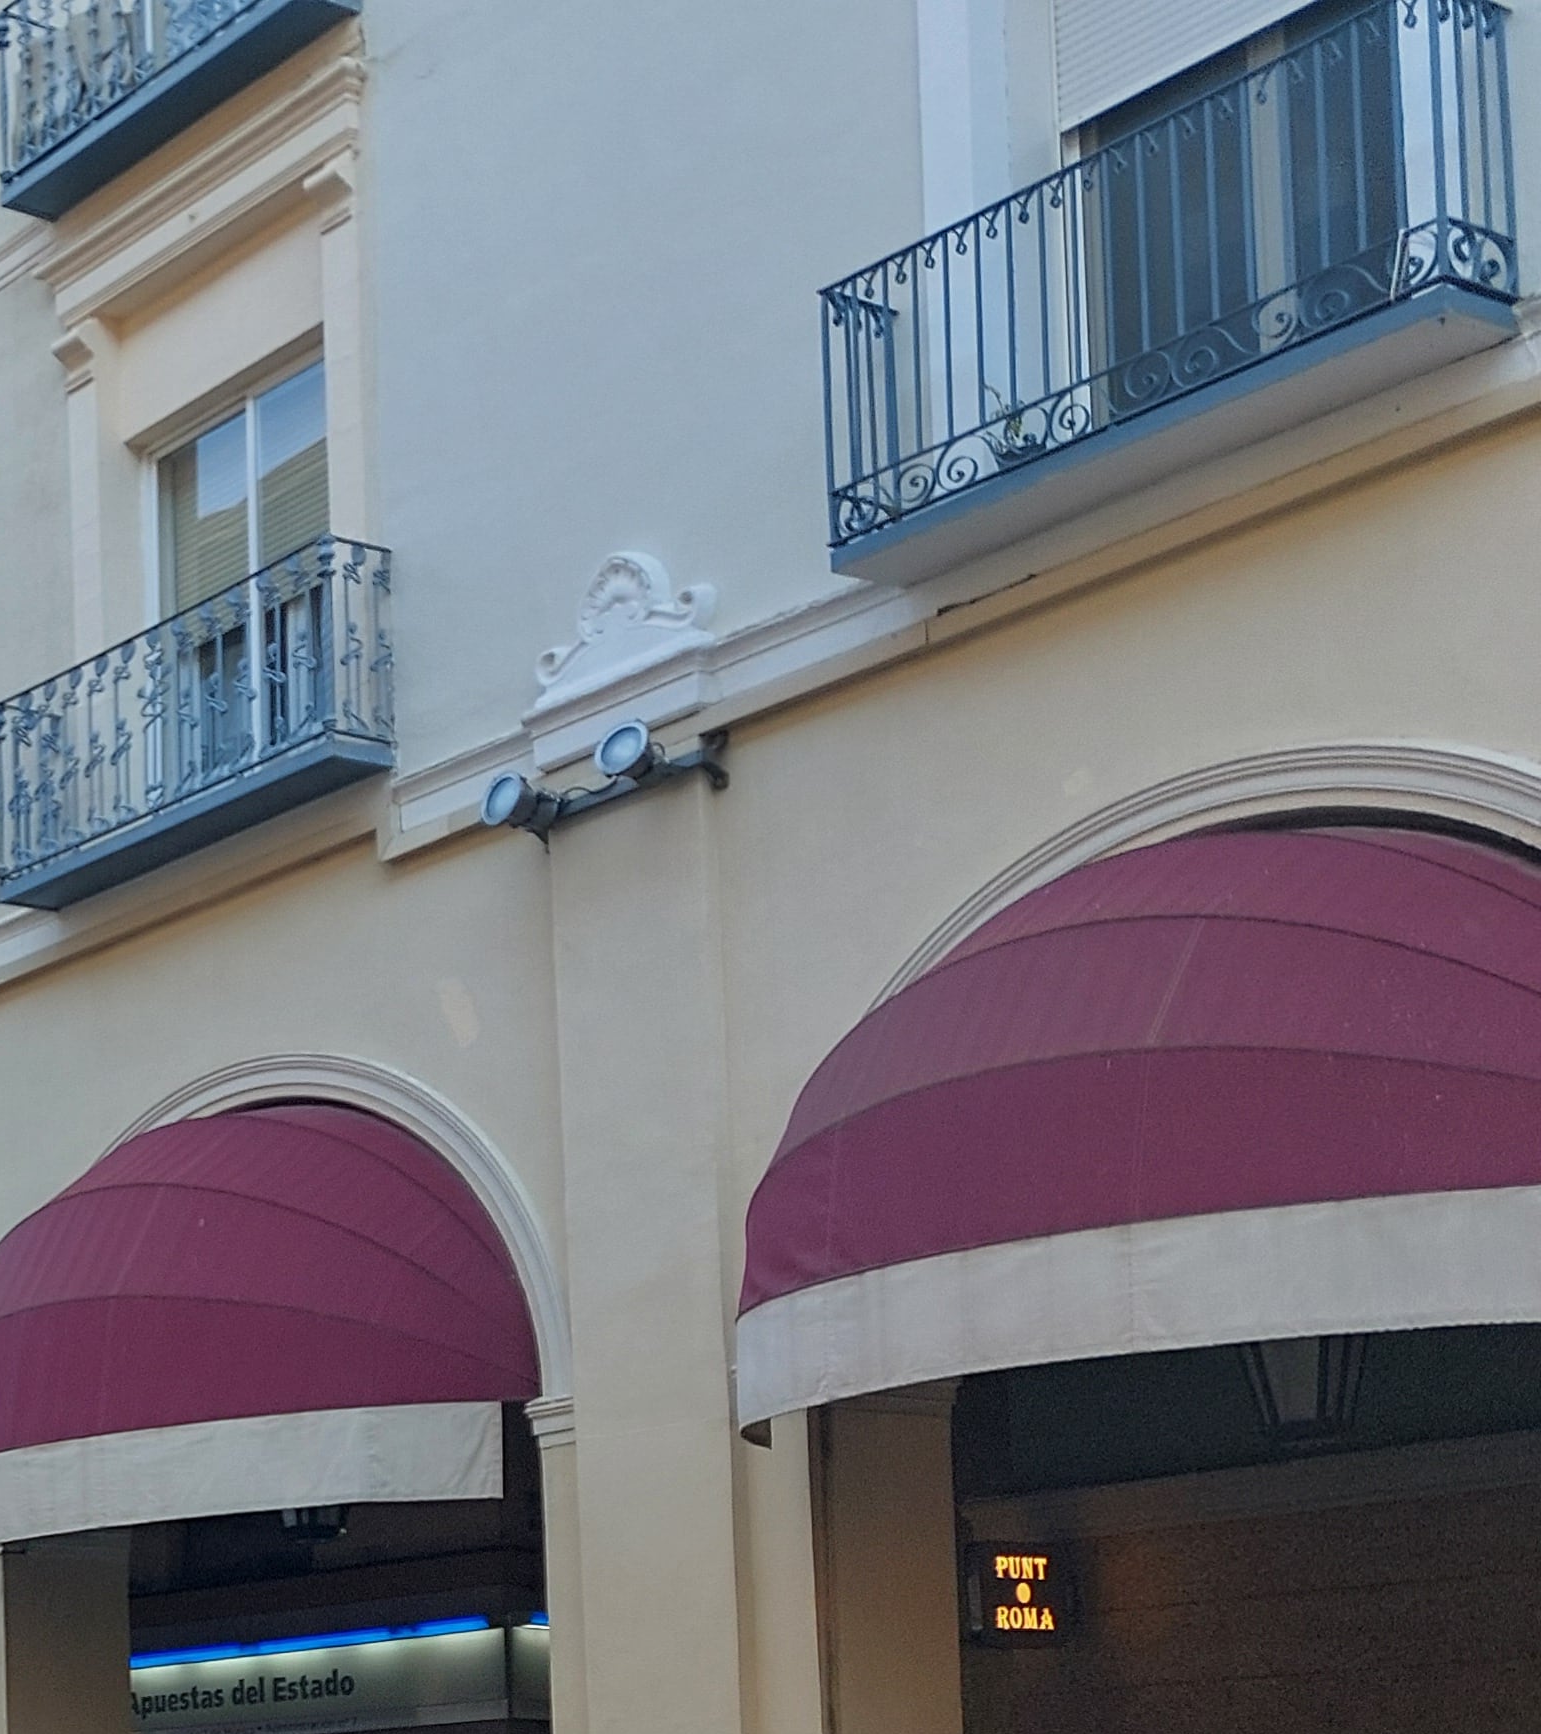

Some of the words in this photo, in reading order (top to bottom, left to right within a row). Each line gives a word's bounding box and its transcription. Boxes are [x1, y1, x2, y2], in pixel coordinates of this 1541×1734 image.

[995, 1556, 1048, 1580] PUNT
[995, 1606, 1055, 1630] ROMA
[232, 1676, 266, 1705] del
[273, 1668, 356, 1701] Estado
